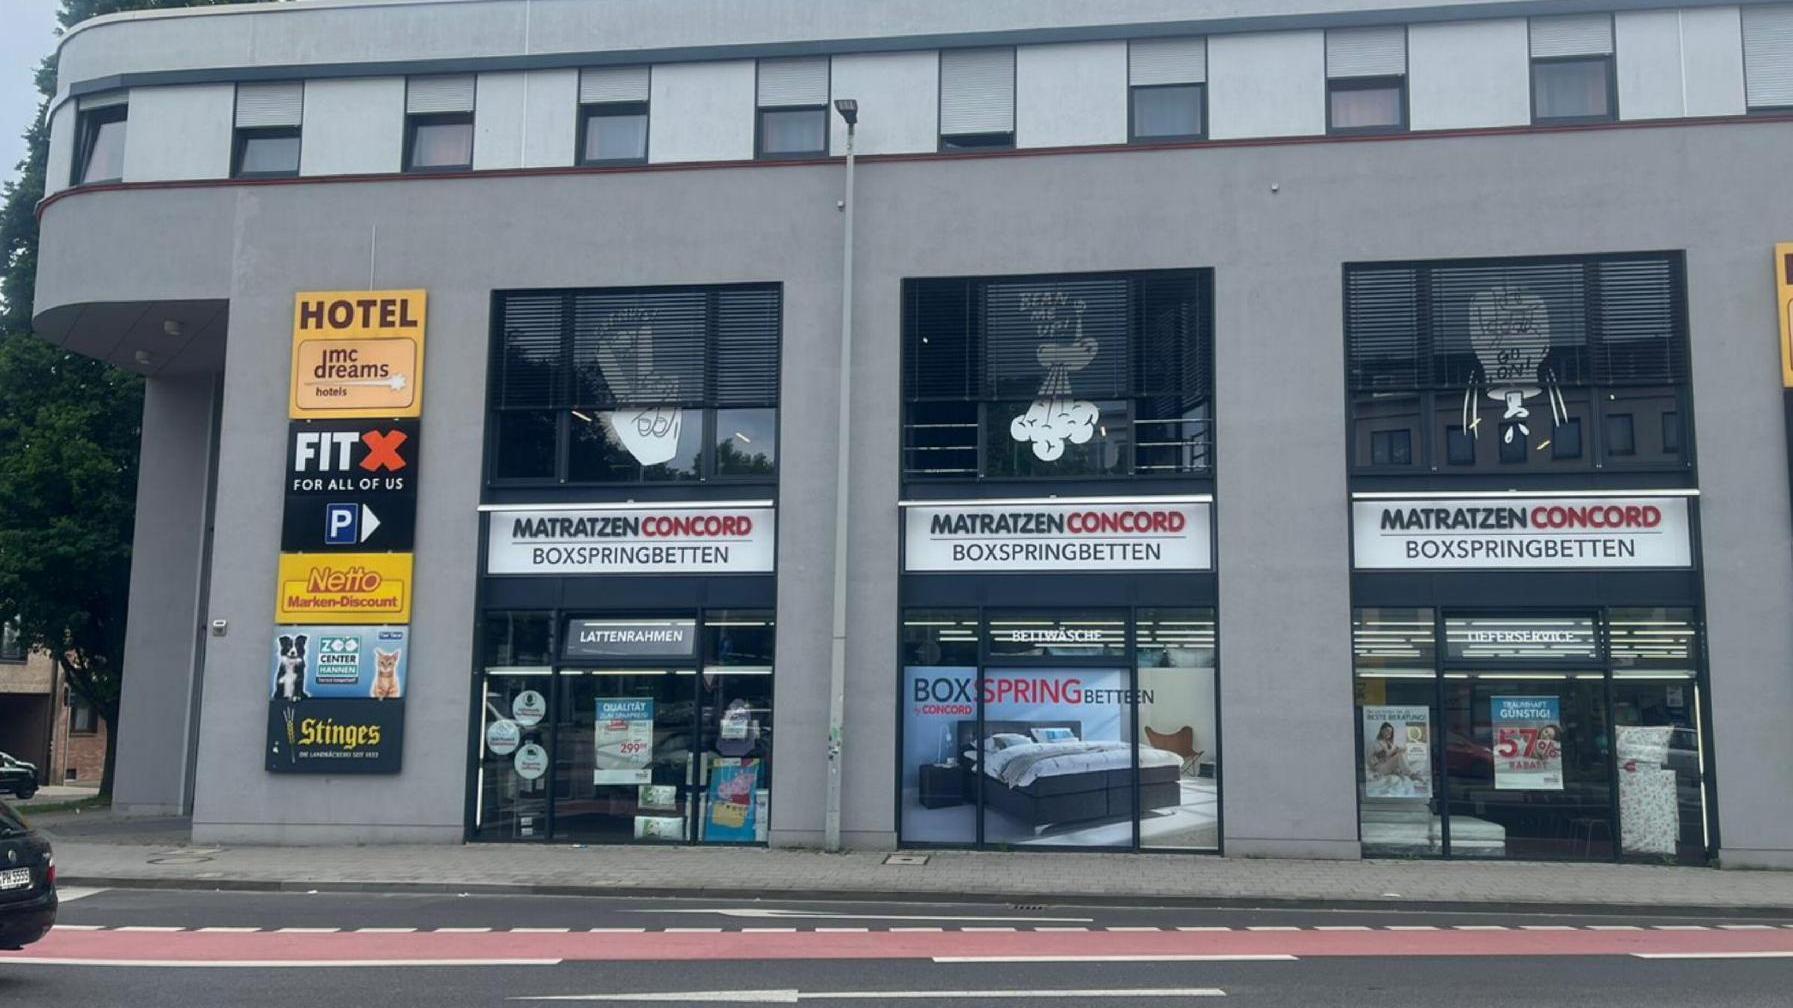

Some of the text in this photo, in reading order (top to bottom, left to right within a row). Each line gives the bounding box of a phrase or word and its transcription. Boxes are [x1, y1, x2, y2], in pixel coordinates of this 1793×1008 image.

[300, 298, 418, 329] HOTEL
[329, 348, 358, 362] mc
[1498, 348, 1520, 363] GO
[314, 350, 389, 379] dreams
[316, 387, 347, 396] hotels
[295, 430, 408, 471] FITX
[294, 478, 403, 490] FOR ALL OF US
[331, 510, 352, 538] P
[513, 515, 752, 538] MATRATZEN CONCORD
[930, 511, 1186, 534] MATRATZEN CONCORD
[1381, 506, 1661, 530] MATRATZEN CONCORD
[532, 546, 728, 564] BOXSPRINGBETTEN
[953, 543, 1160, 561] BOXSPRINGBETTEN
[1406, 539, 1635, 558] BOXSPRINGBETTEN
[307, 567, 381, 593] Netto
[288, 595, 398, 608] Marken-Discount
[580, 630, 683, 642] LATTENRAHMEN
[1012, 627, 1104, 642] BETTWÄSCHE
[1468, 630, 1575, 643] LIEFERSERVICE
[320, 655, 356, 663] CENTER
[603, 702, 646, 712] QUALITÄT
[922, 704, 973, 715] CONCORD
[1500, 707, 1551, 718] GÜNSTIG!
[299, 718, 380, 749] Stinges
[1499, 727, 1557, 759] 57%
